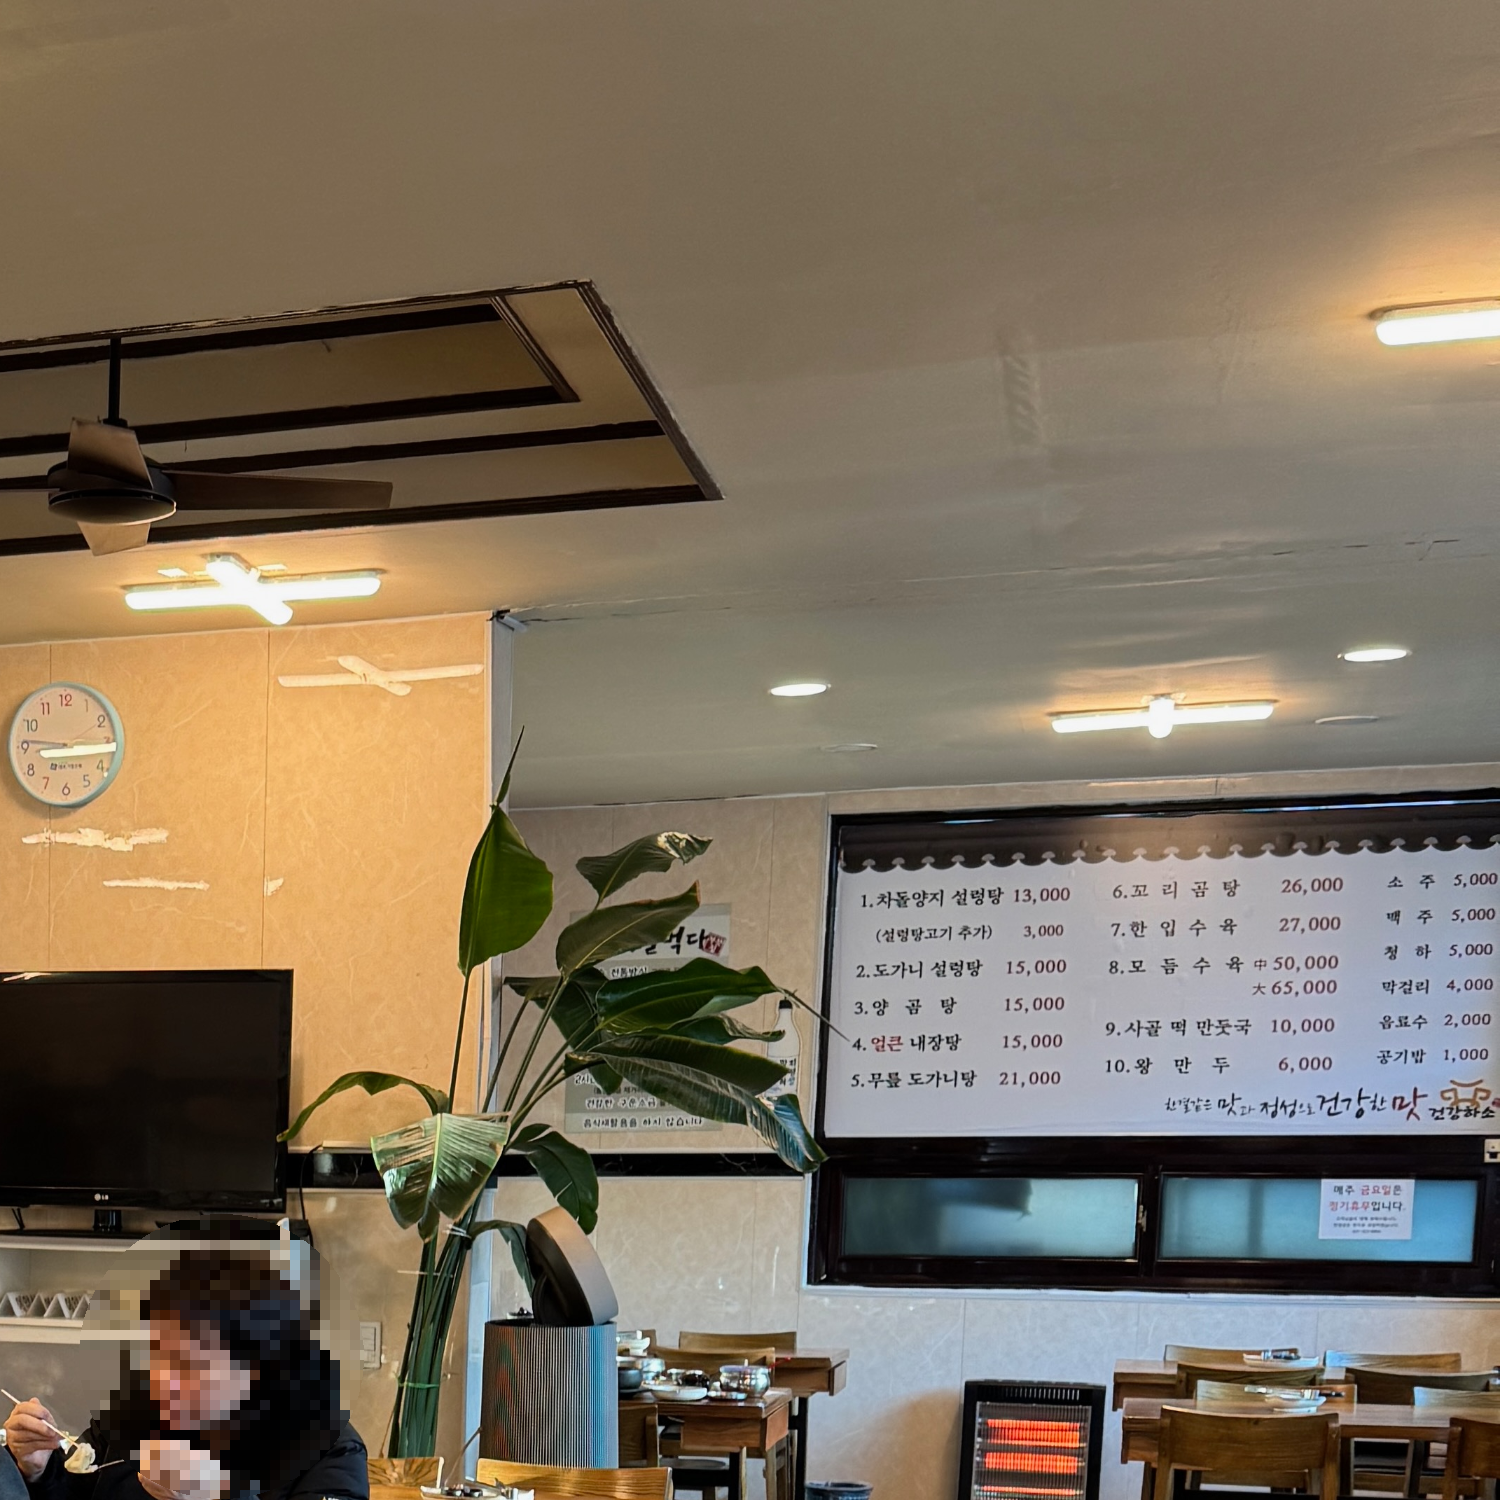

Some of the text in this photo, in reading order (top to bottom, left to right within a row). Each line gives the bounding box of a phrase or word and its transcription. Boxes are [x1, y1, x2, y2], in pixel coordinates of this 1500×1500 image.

[40, 702, 50, 715] 11
[59, 693, 72, 707] 12
[23, 719, 38, 732] 10
[97, 714, 106, 728] 2
[21, 740, 30, 754] 9
[27, 763, 35, 776] 8
[96, 759, 104, 772] 4
[42, 777, 50, 789] 7
[61, 782, 71, 796] 6
[83, 774, 91, 787] 5
[1281, 877, 1343, 896] 26,000
[1453, 872, 1498, 889] 5,000
[951, 887, 1004, 906] 설렁탕
[1013, 887, 1071, 905] 13,000
[1451, 907, 1496, 923] 5,000
[958, 924, 992, 941] 추가)
[1023, 924, 1064, 940] 3,000
[1279, 916, 1341, 935] 27,000
[1449, 943, 1493, 959] 5,000
[930, 959, 983, 978] 설렁탕
[1006, 959, 1067, 977] 15,000
[1253, 959, 1267, 971] 中
[1272, 954, 1339, 973] 50,000
[1252, 980, 1337, 998] 大 65,000
[1382, 979, 1493, 995] 막걸리 4,000
[1004, 997, 1065, 1014] 15,000
[1271, 1018, 1335, 1036] 10,000
[1379, 1013, 1491, 1030] 음료수 2,000
[910, 1033, 962, 1053] 내장탕
[1002, 1034, 1063, 1051] 15,000
[1278, 1056, 1332, 1073] 6,000
[1377, 1048, 1489, 1065] 공기밥 1,000
[908, 1069, 977, 1089] 도가니탕
[999, 1070, 1061, 1088] 21,000
[1392, 1086, 1428, 1121] 맛
[1429, 1105, 1496, 1120] 건강하소
[1333, 1184, 1403, 1196] 매주 금요일은
